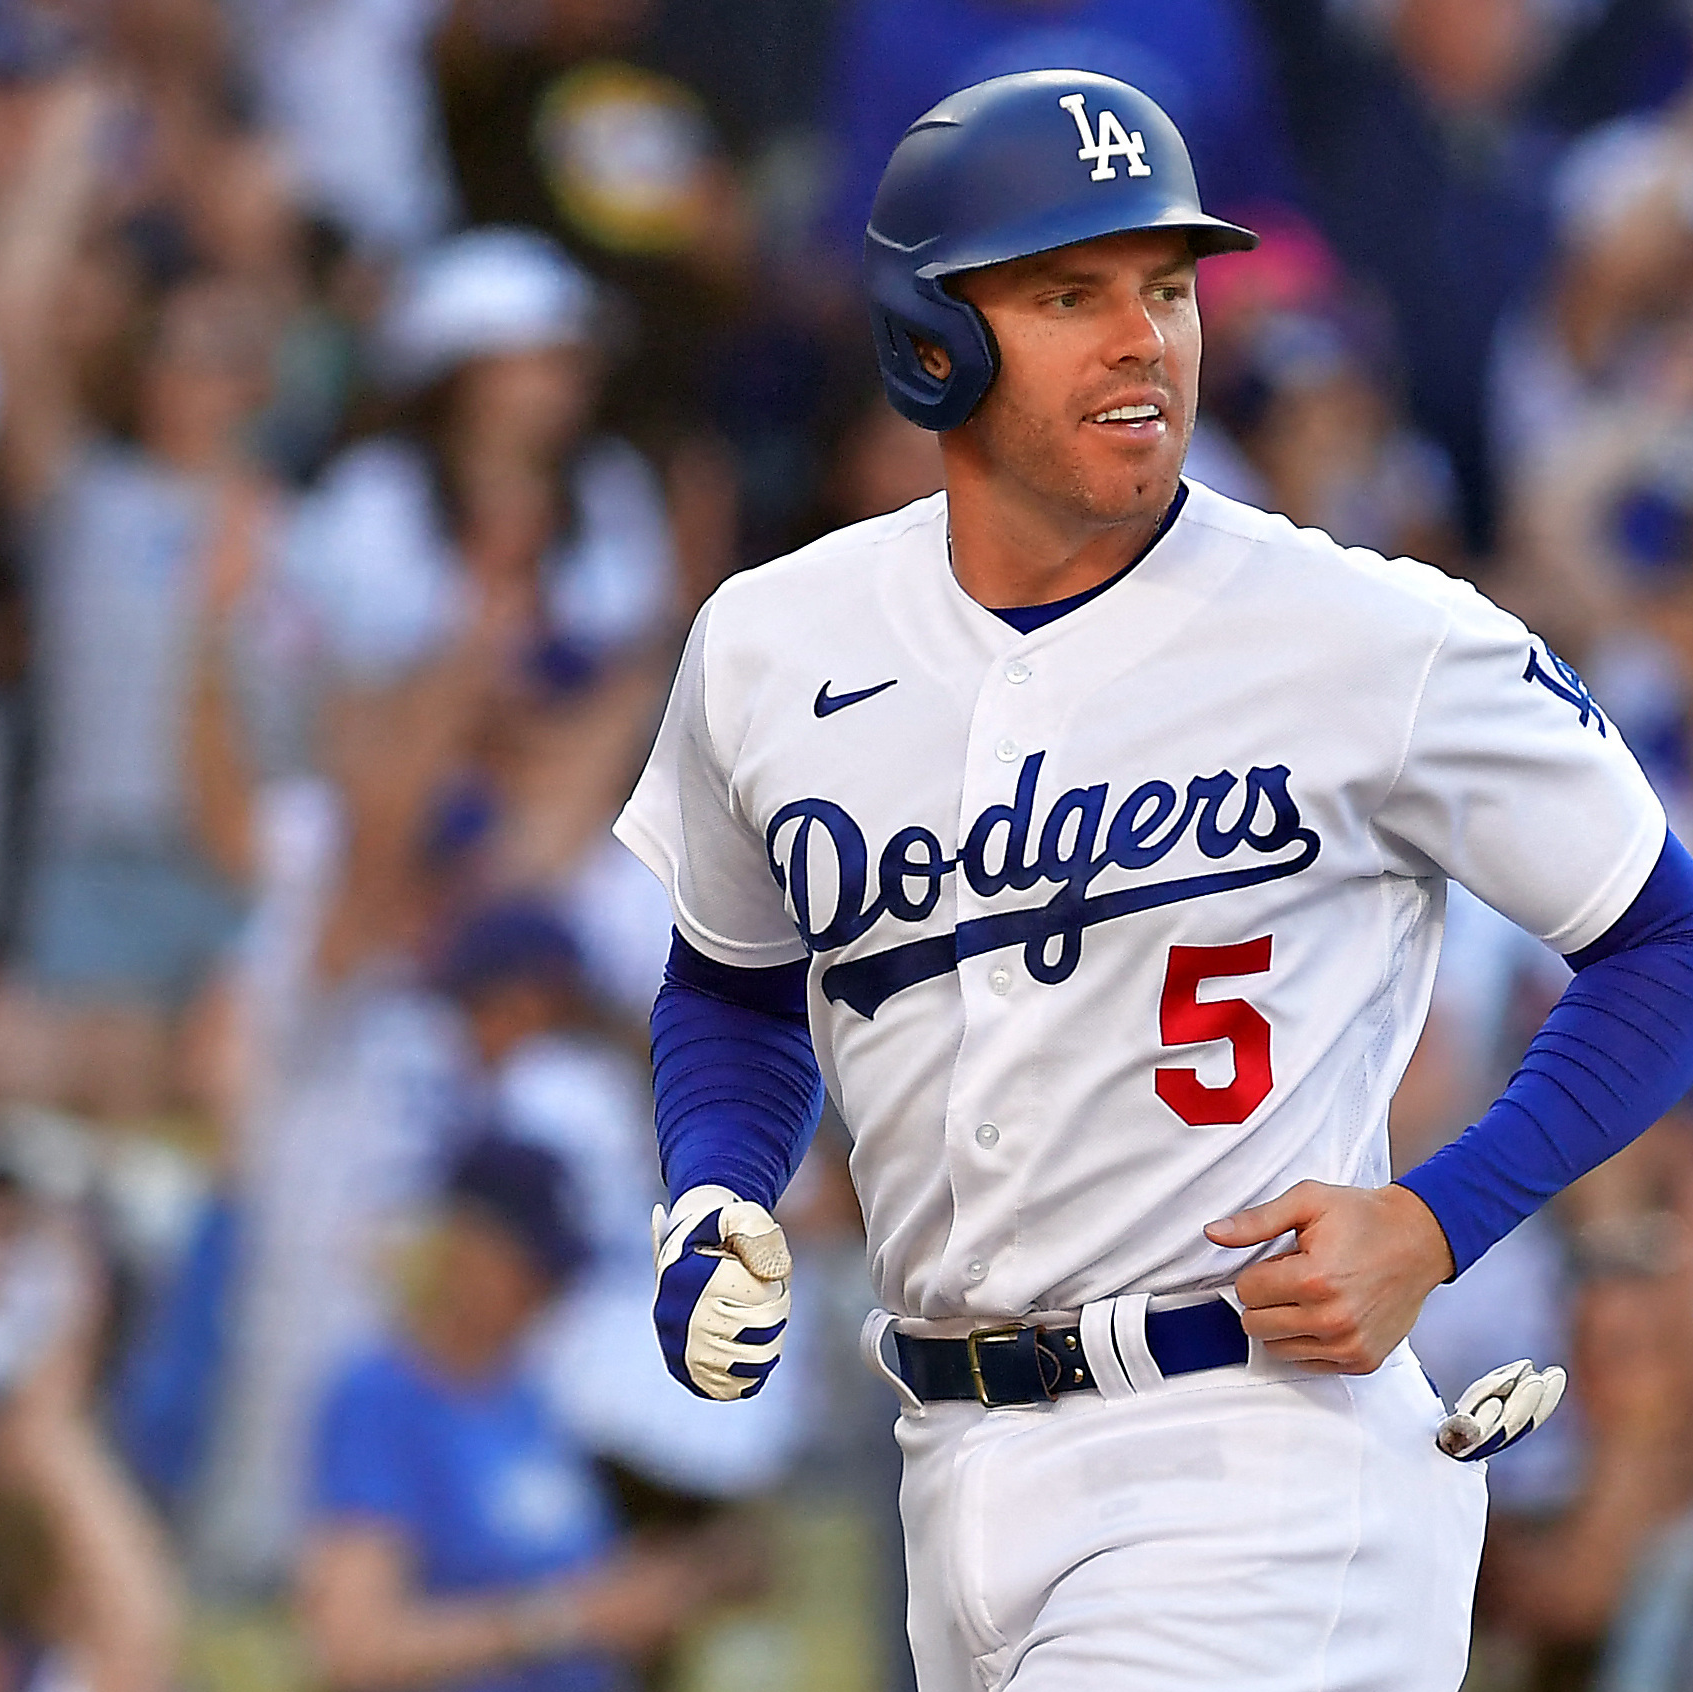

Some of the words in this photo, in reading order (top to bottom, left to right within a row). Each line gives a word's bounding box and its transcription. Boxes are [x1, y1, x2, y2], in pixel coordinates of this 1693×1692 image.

[1059, 93, 1152, 181] LA
[765, 749, 1321, 986] Dodgers
[1154, 934, 1274, 1127] 5
